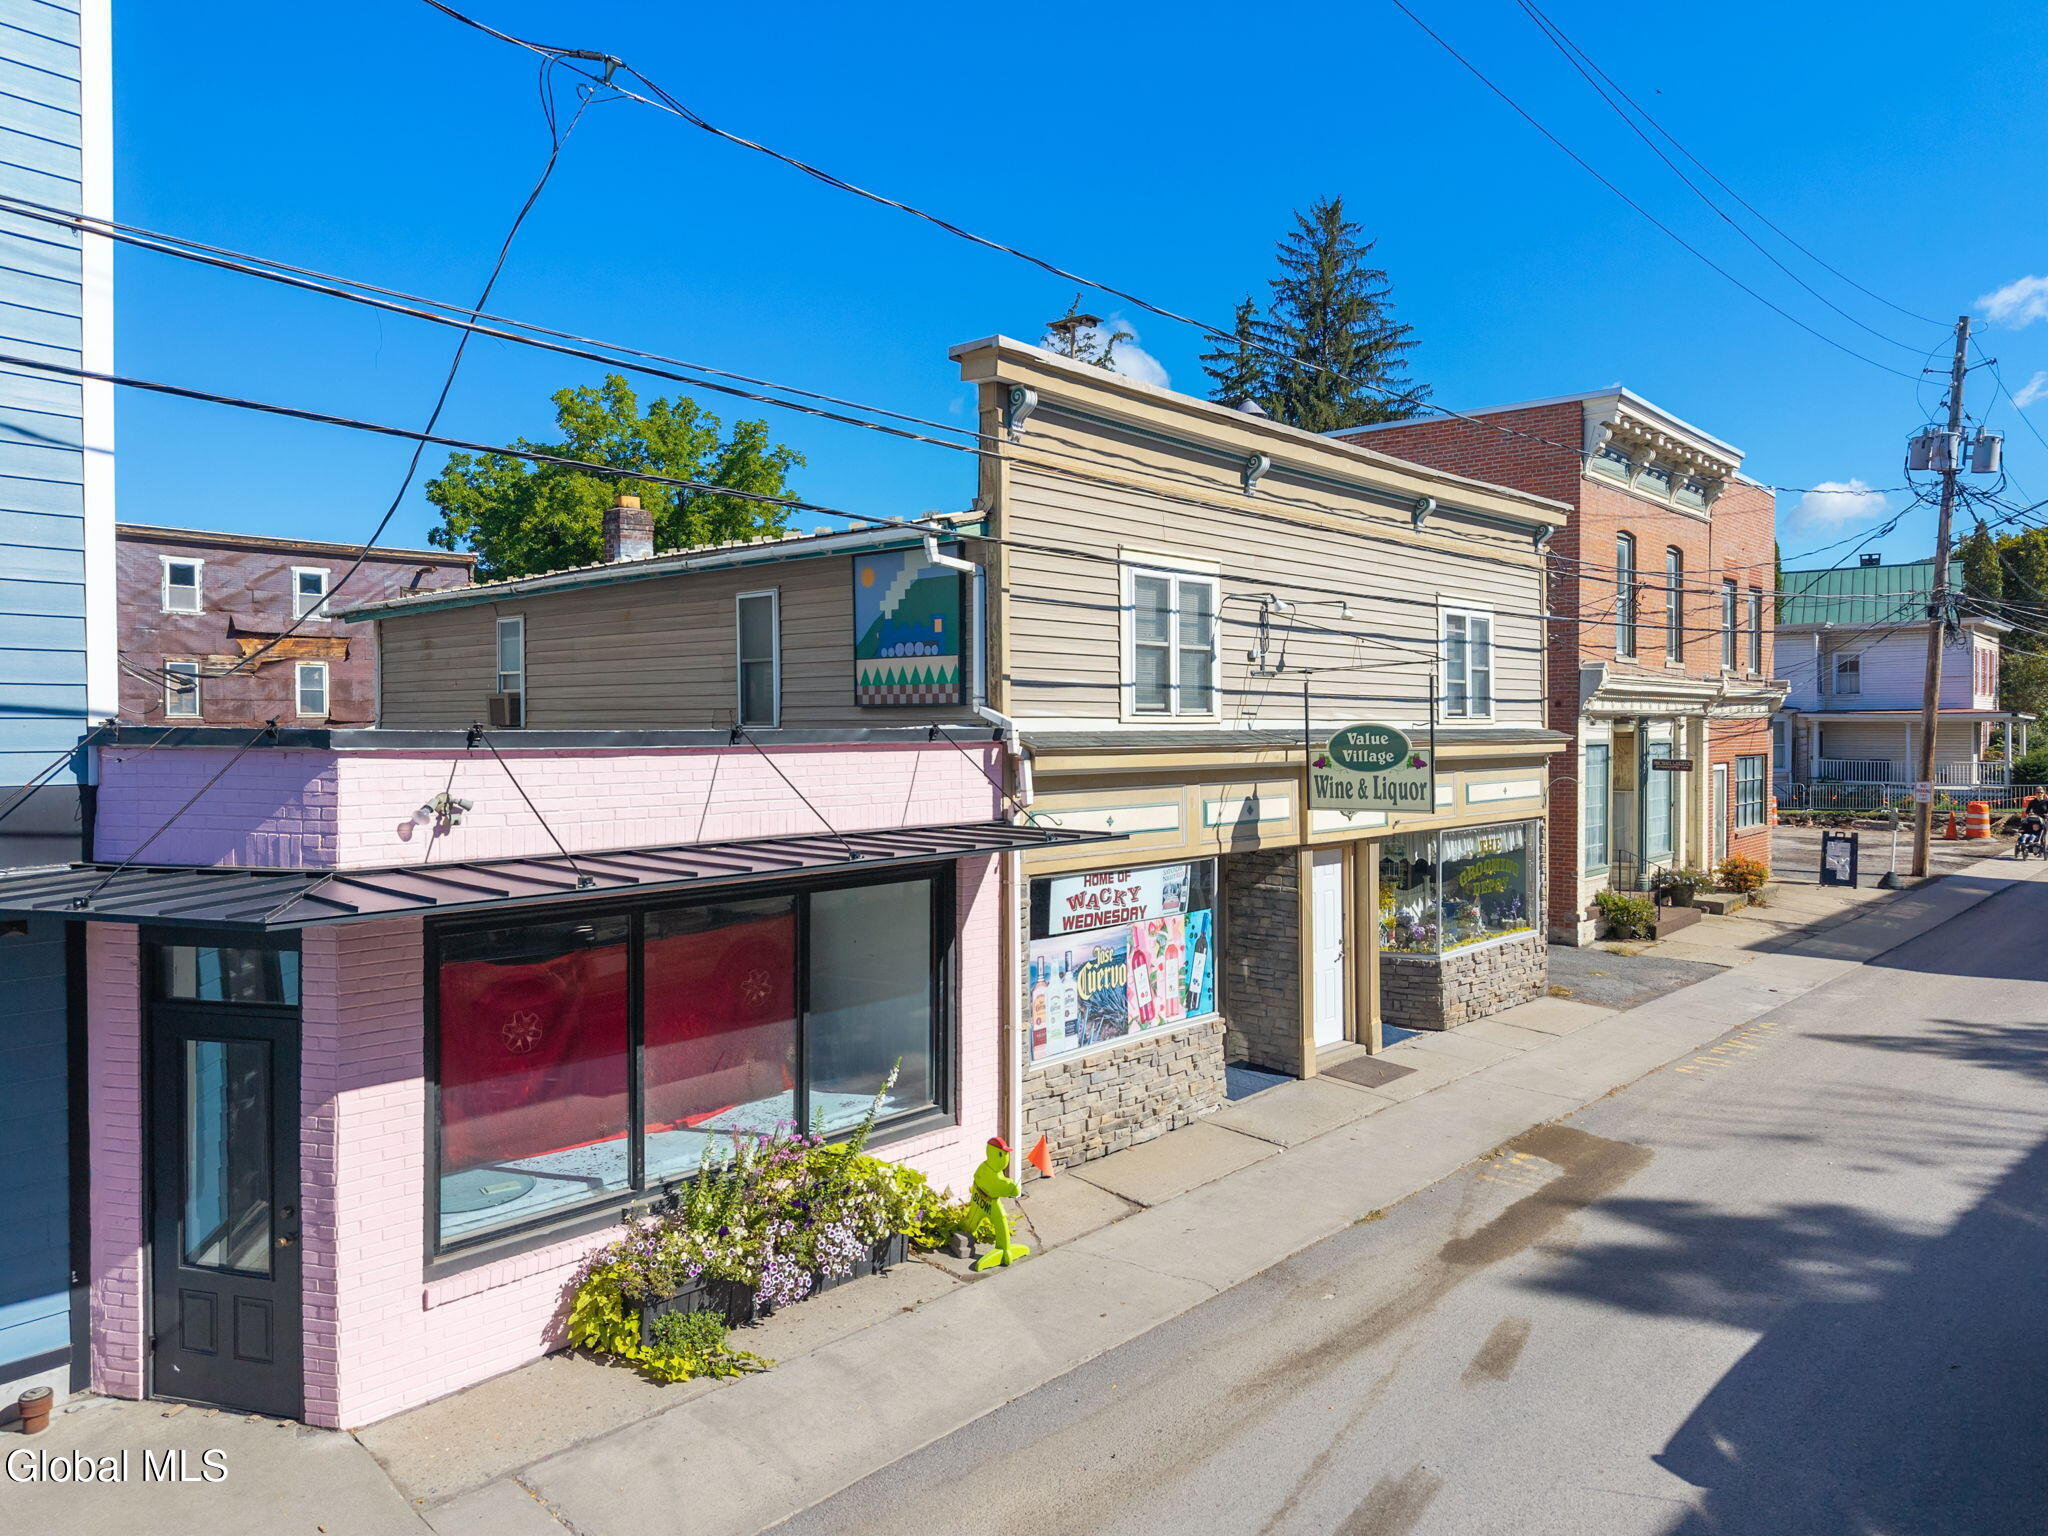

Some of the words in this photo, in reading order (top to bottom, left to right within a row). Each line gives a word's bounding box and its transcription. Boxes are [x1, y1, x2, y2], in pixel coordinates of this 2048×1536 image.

[1347, 732, 1389, 745] Value
[1342, 750, 1395, 765] Village
[1313, 775, 1353, 800] Wine
[1358, 778, 1368, 800] &
[1373, 775, 1428, 806] Liquor
[1480, 838, 1501, 855] THE
[1084, 873, 1114, 887] HOME
[1118, 871, 1131, 883] OF
[1066, 886, 1141, 911] WACKY
[1062, 905, 1147, 931] WEDNESDAY
[1077, 962, 1127, 1000] Cuervo
